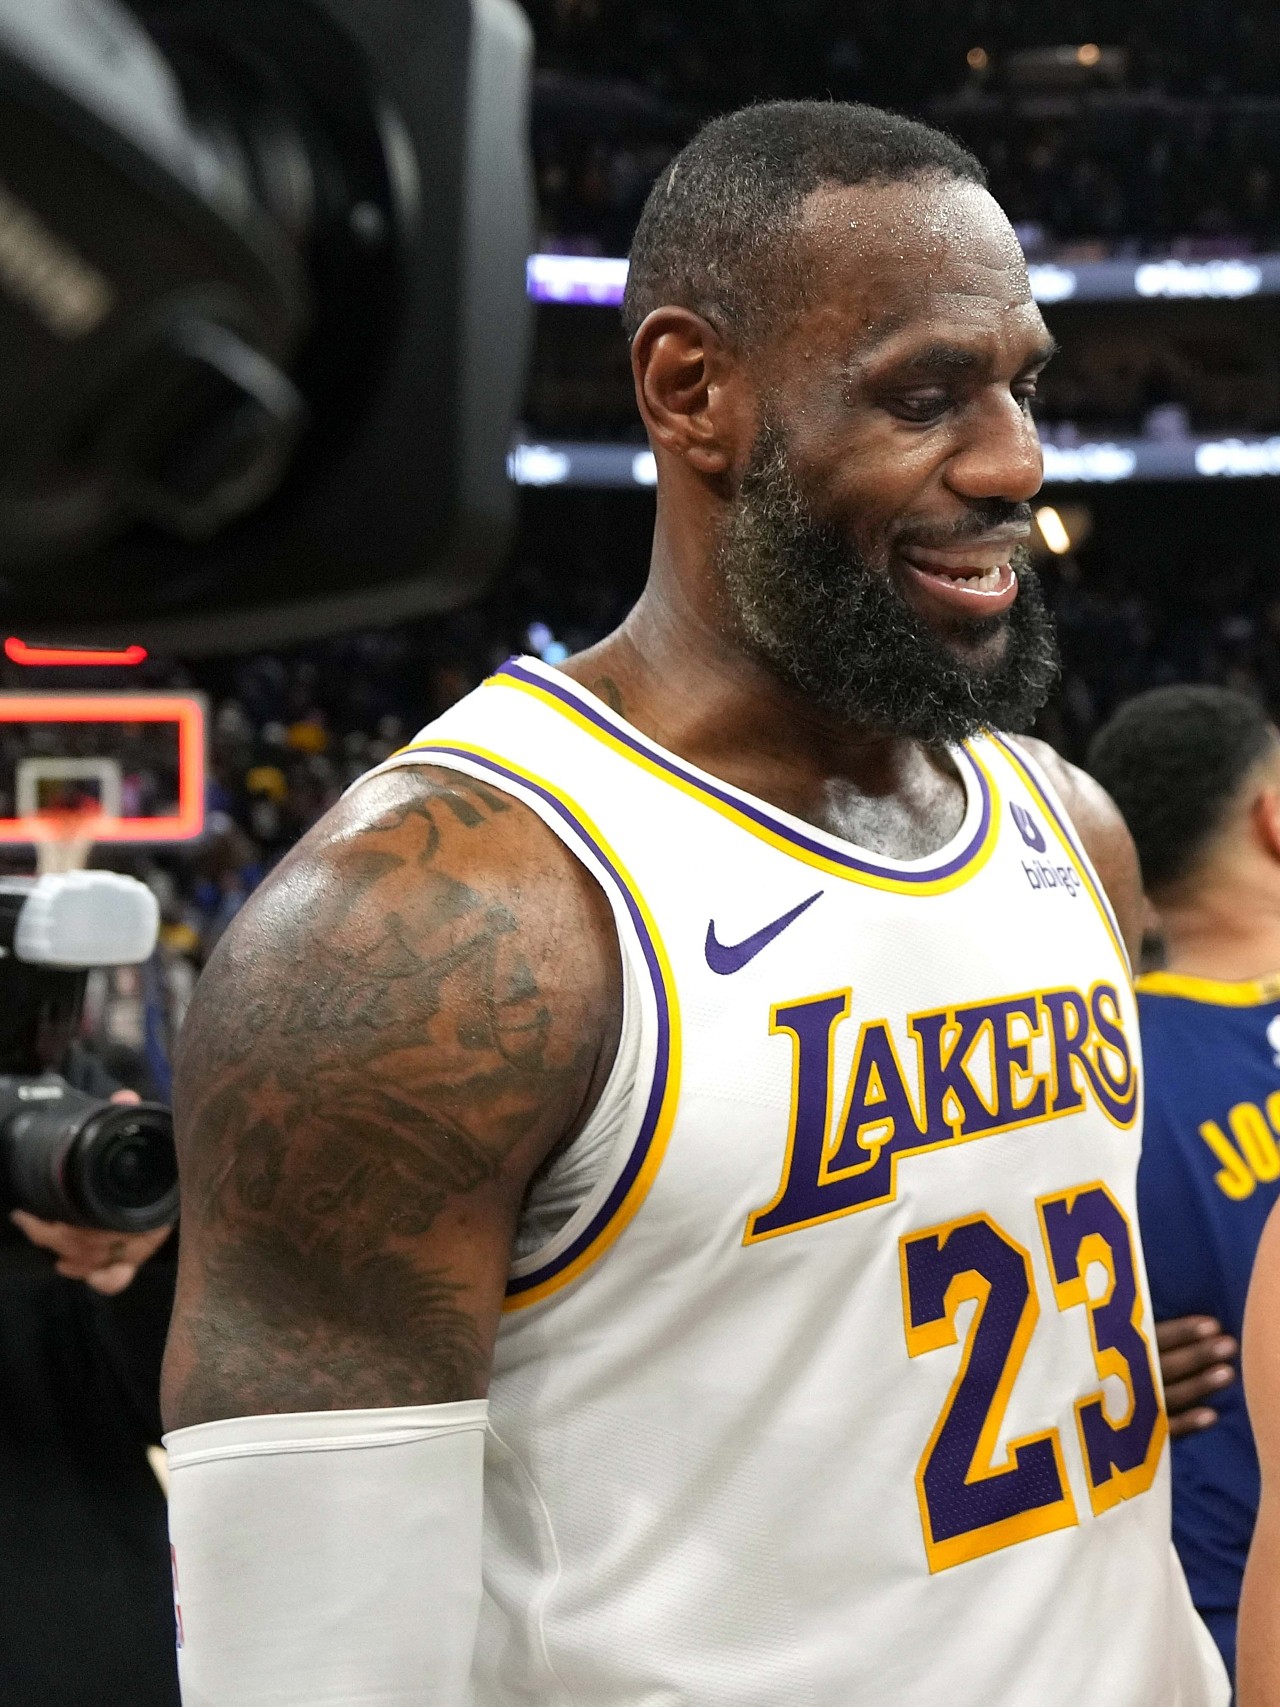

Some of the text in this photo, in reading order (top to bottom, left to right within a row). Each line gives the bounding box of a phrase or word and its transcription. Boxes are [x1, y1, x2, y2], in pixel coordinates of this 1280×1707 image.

[1021, 860, 1080, 897] bibigo
[741, 980, 1138, 1246] LAKERS
[899, 1180, 1168, 1574] 23
